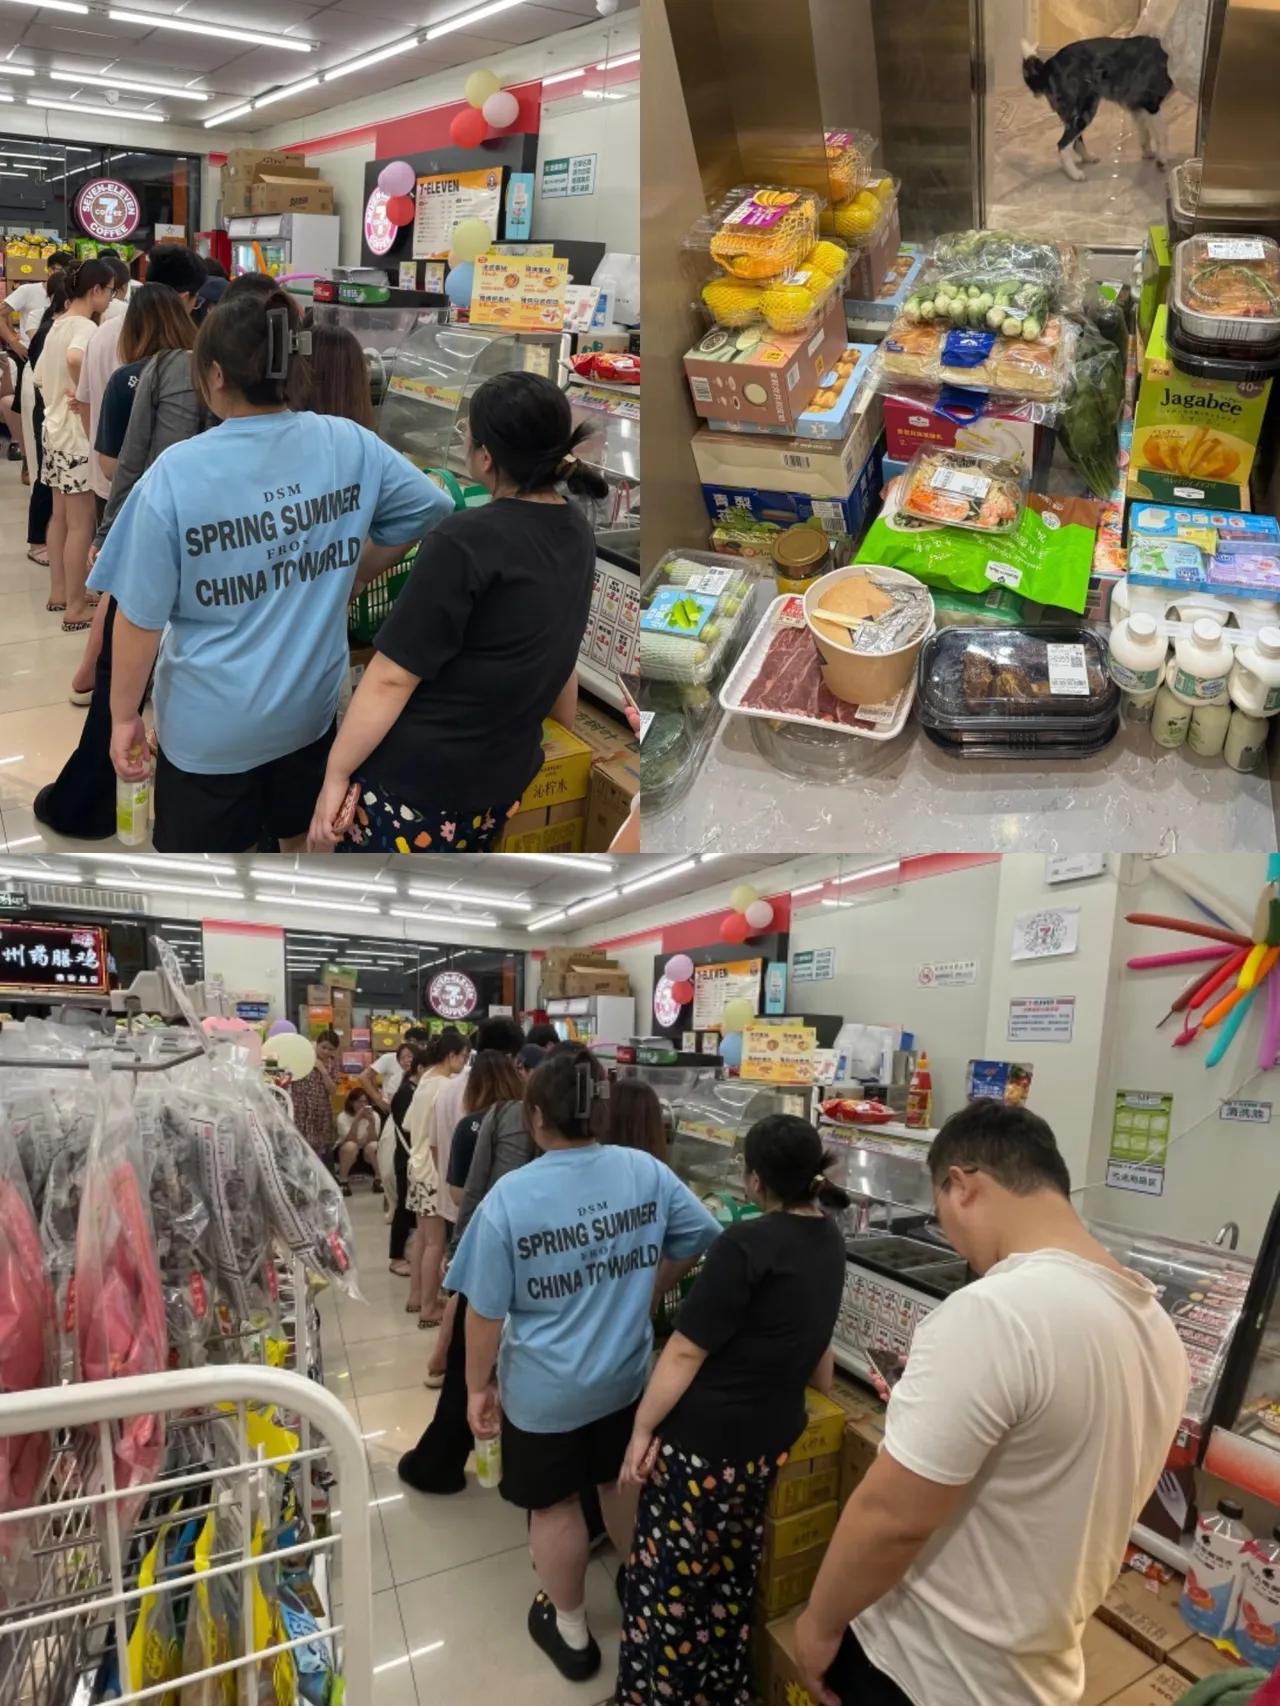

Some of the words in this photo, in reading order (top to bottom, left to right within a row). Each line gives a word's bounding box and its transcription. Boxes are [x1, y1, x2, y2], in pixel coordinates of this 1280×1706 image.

[82, 183, 136, 215] SEVEN-ELEVEN
[99, 197, 118, 223] 7
[90, 222, 128, 238] COFFEE
[1160, 387, 1243, 417] Jagabee
[263, 483, 302, 503] DSM
[185, 511, 278, 557] SPRING
[280, 483, 361, 536] SUMMER
[195, 570, 267, 607] CHINA
[272, 559, 297, 591] TO
[298, 536, 361, 583] WORLD
[577, 1201, 608, 1217] DSM
[517, 1222, 589, 1260] SPRING
[592, 1201, 657, 1242] SUMMER
[580, 1244, 616, 1261] FRO
[527, 1269, 583, 1300] CHINA
[585, 1262, 606, 1286] TO
